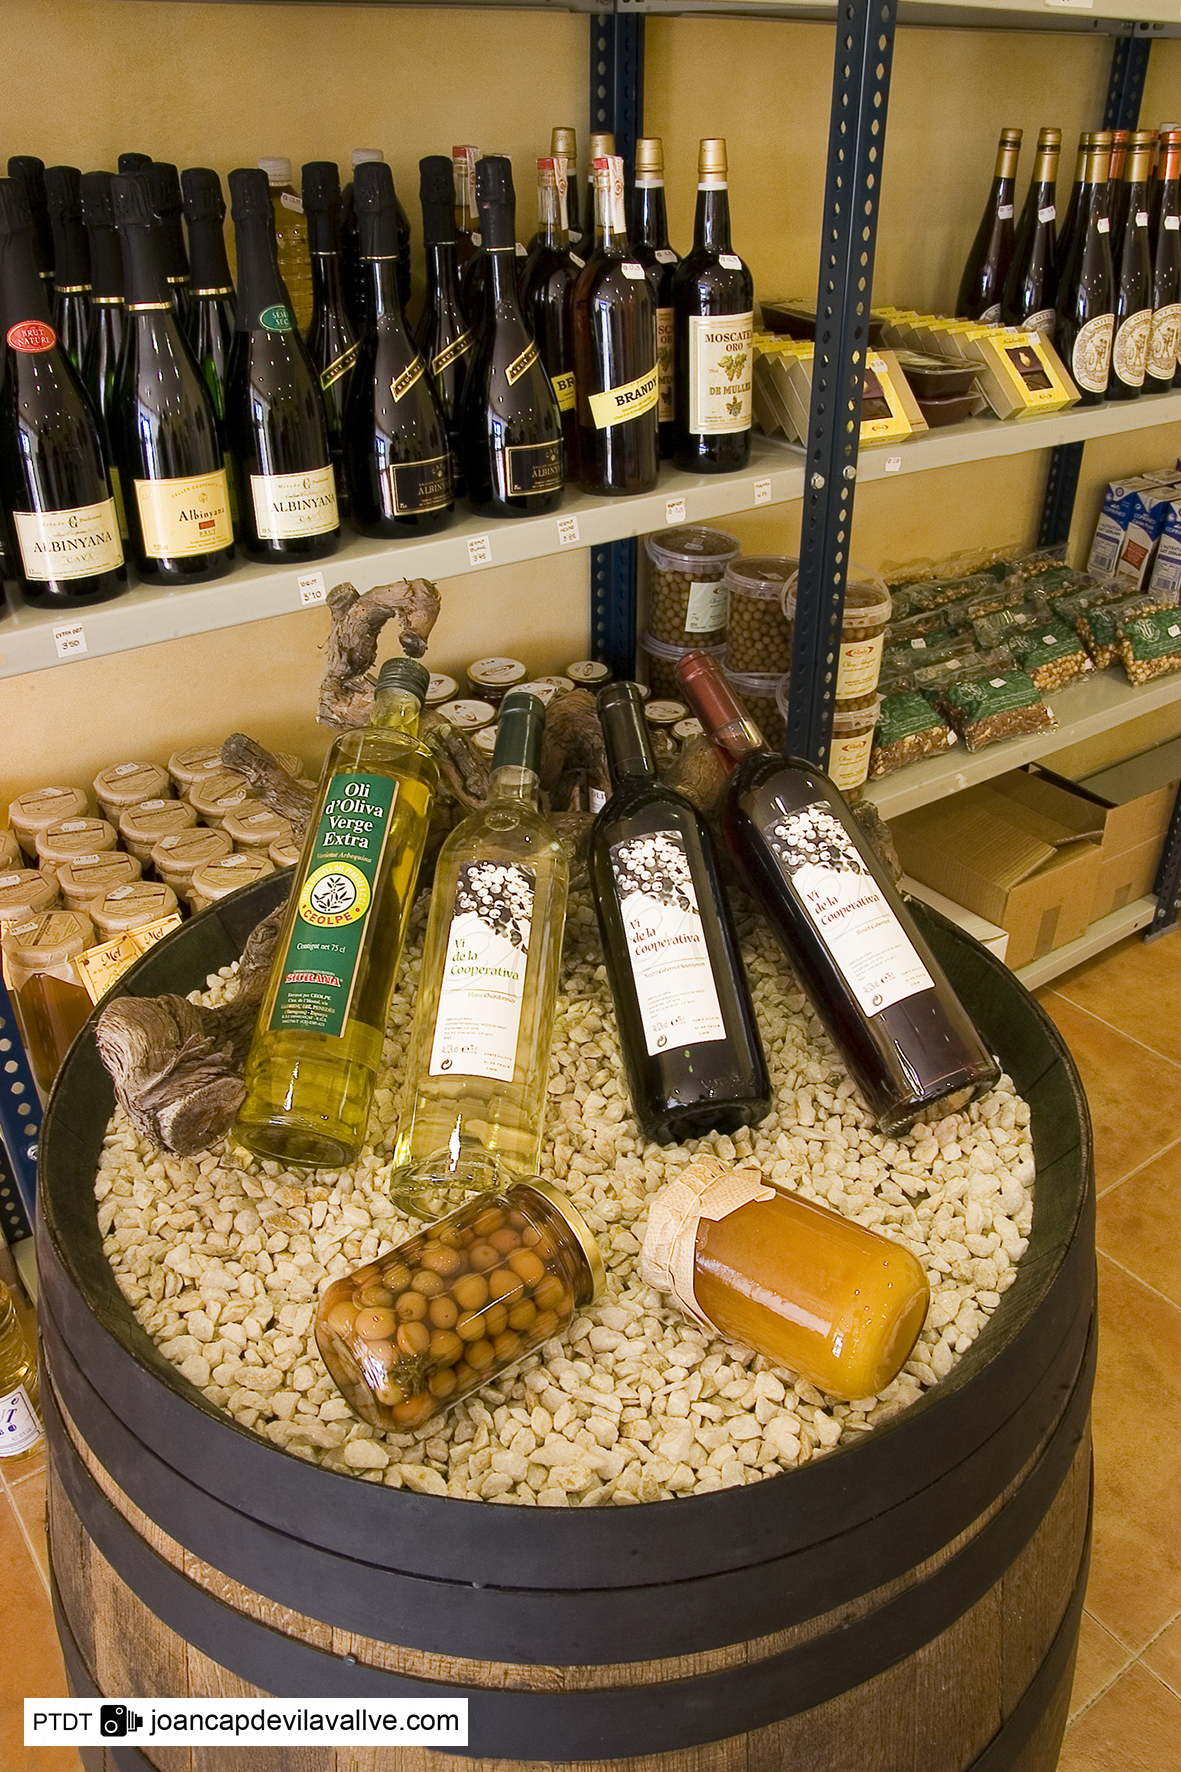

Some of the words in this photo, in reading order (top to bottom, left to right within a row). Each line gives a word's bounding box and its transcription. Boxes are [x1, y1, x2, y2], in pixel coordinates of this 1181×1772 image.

[276, 318, 290, 326] SEC
[21, 328, 45, 337] BRUT
[16, 335, 53, 346] NATURE
[726, 342, 744, 353] ORO
[615, 376, 657, 407] BRANDY
[709, 386, 722, 395] DE
[179, 508, 225, 522] Albinyana
[33, 531, 113, 554] ALBINYANA
[61, 639, 81, 650] 3'50
[344, 782, 371, 798] Oli
[329, 815, 374, 834] Verge
[322, 832, 369, 849] Extra
[806, 890, 819, 901] Vi
[815, 902, 827, 914] de
[821, 894, 880, 926] Cooperativa
[303, 909, 353, 925] CEOLPE
[630, 919, 641, 930] Vi
[143, 927, 164, 945] Mel
[632, 931, 645, 943] de
[455, 938, 465, 949] Vi
[635, 933, 700, 956] Cooperativa
[101, 946, 121, 966] Mel
[452, 951, 466, 962] de
[450, 964, 519, 981] Cooperativa
[285, 972, 341, 988] SIURANA
